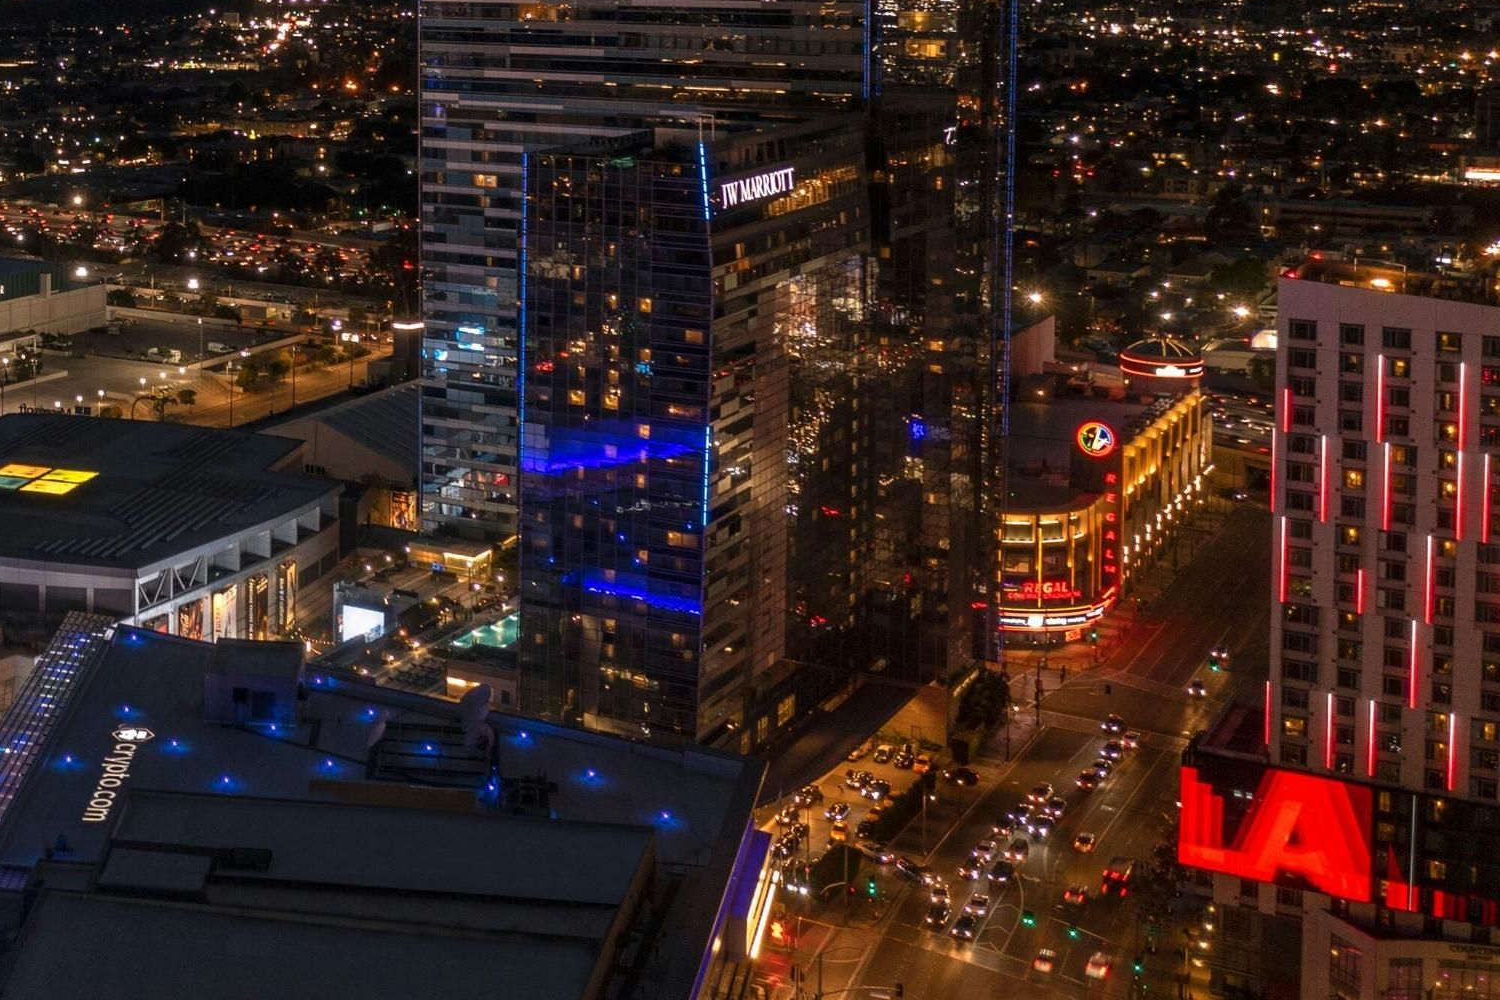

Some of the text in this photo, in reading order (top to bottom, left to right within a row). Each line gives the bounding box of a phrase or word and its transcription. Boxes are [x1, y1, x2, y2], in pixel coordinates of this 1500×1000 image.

[721, 167, 794, 209] JW MARRIOTT
[1105, 473, 1116, 559] REGAL
[1023, 582, 1068, 593] REGAL
[82, 743, 137, 821] crypto.com
